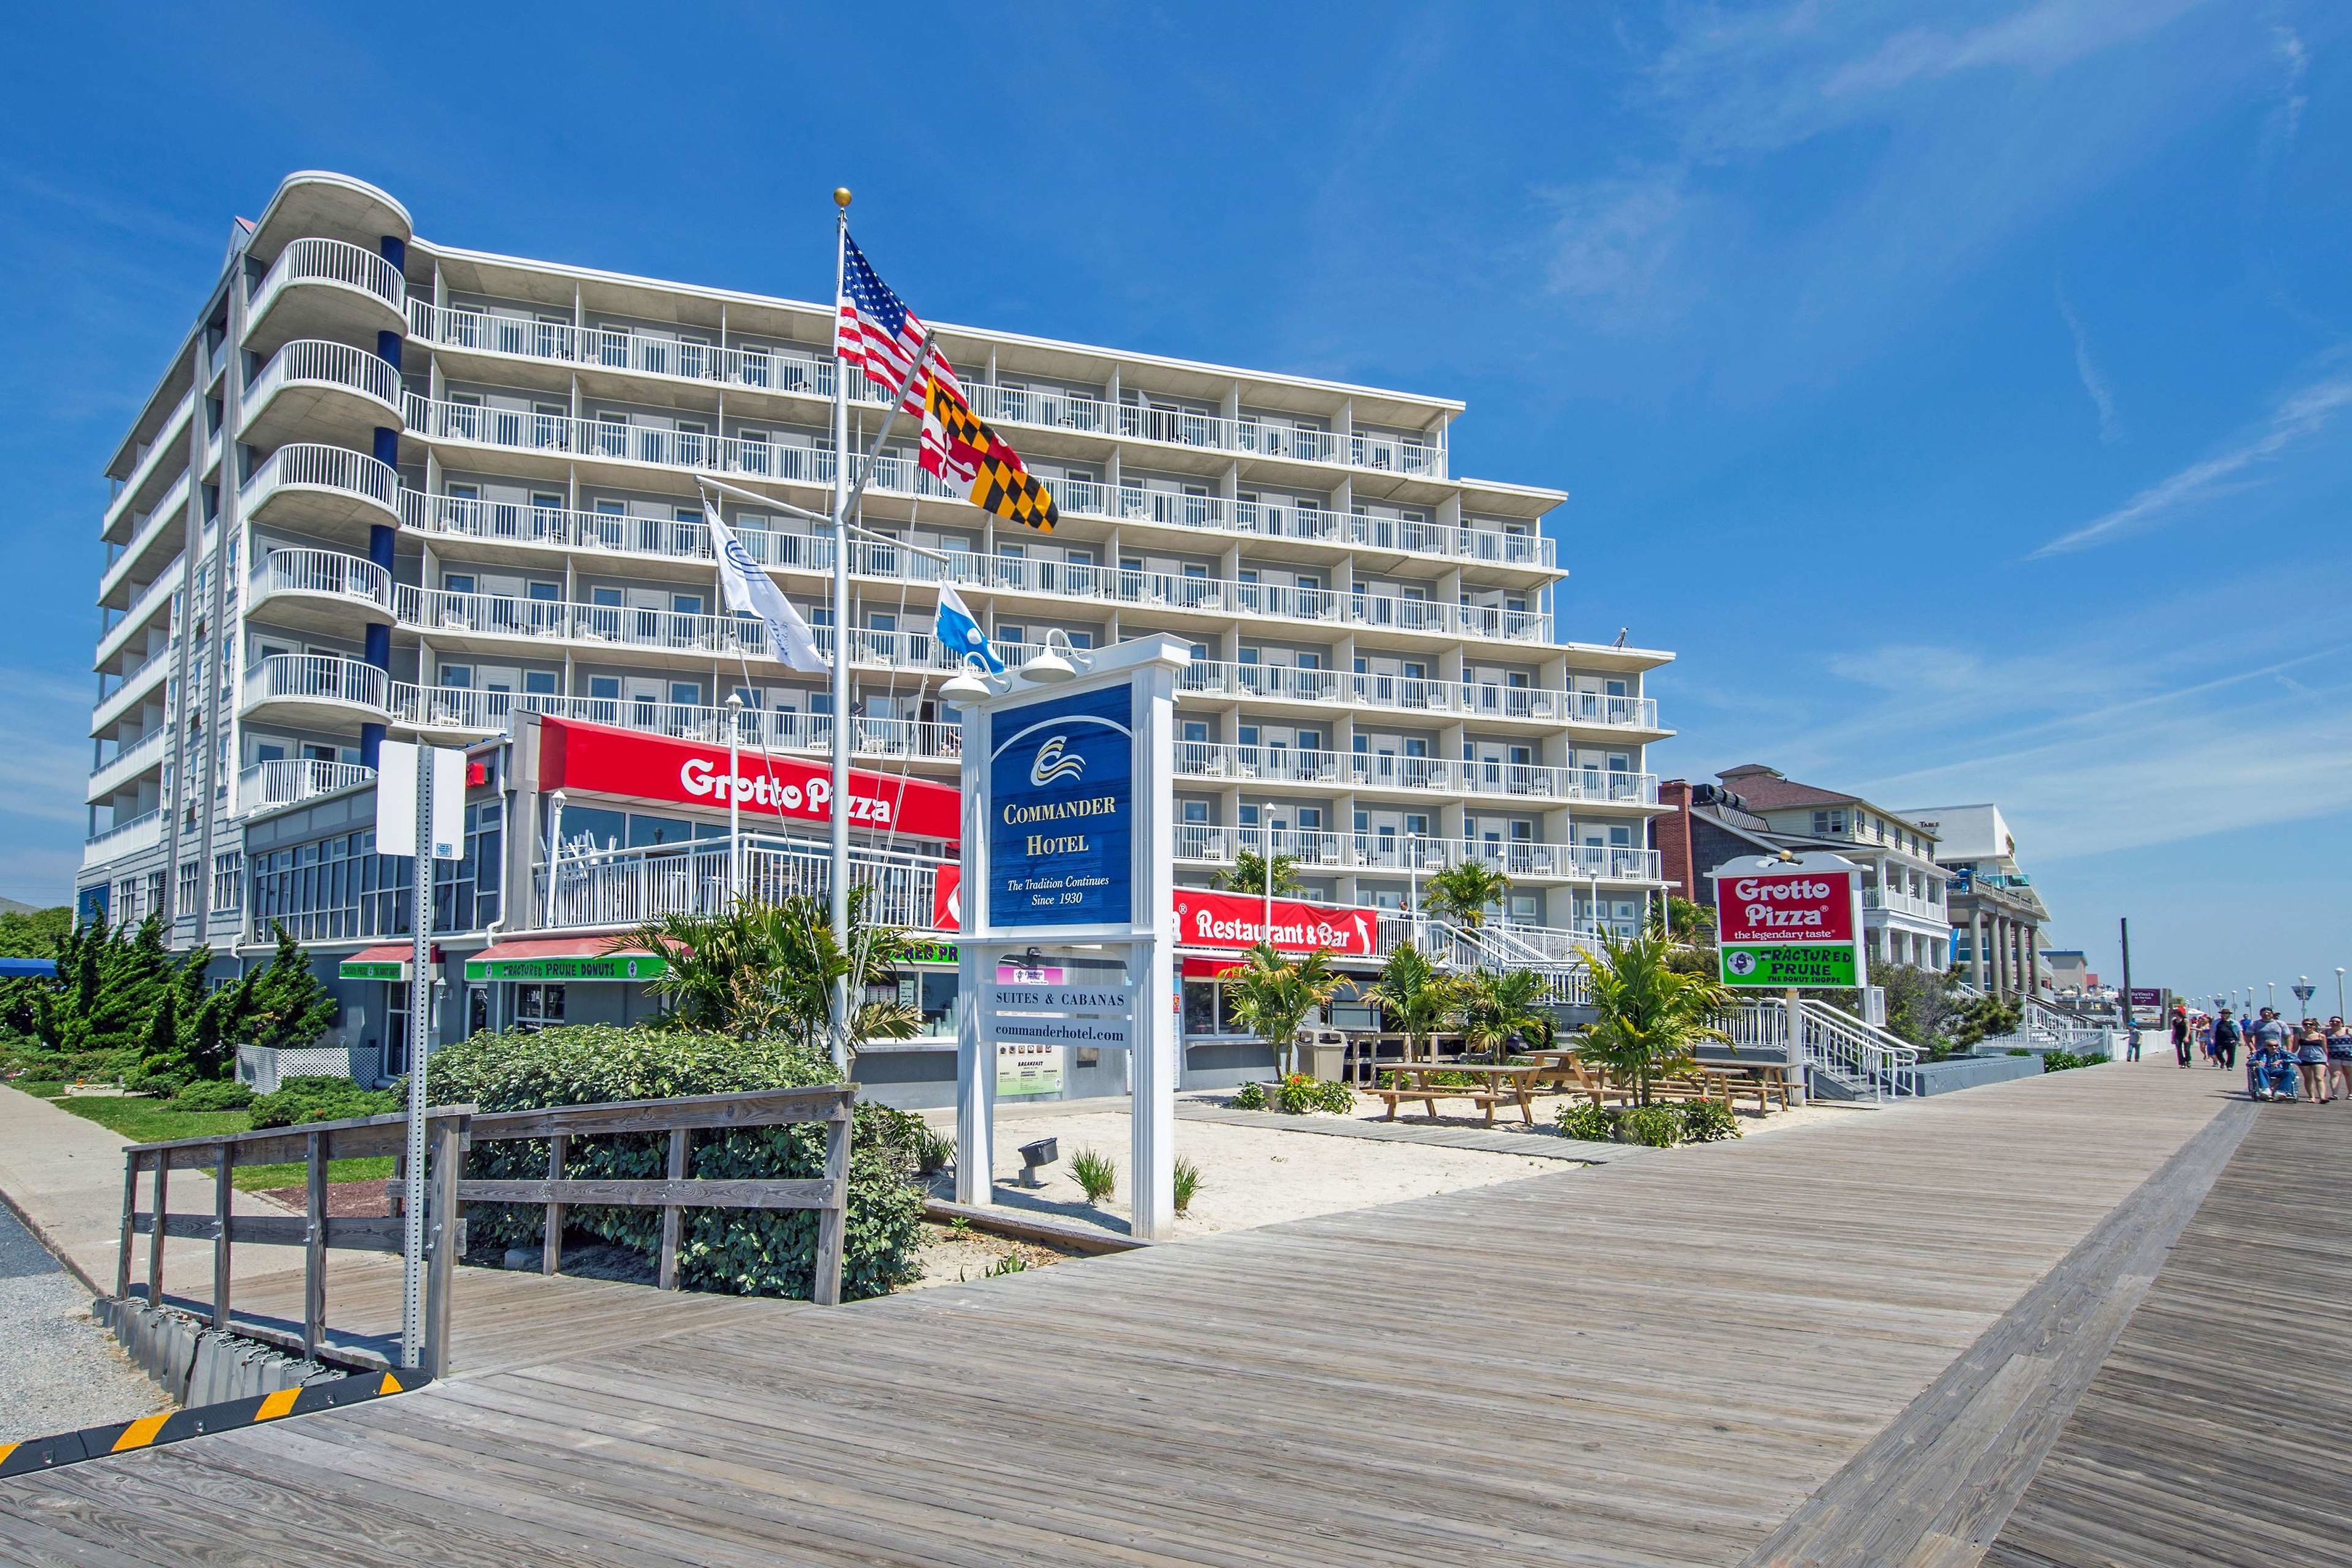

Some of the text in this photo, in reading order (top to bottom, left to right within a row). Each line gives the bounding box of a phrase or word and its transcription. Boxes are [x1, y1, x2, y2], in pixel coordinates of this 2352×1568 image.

[680, 758, 891, 823] Grotto Pzza
[1003, 796, 1116, 825] COMMANDER
[1026, 835, 1089, 857] HOTEL
[1008, 875, 1109, 891] The Tradition Continues
[1735, 878, 1830, 901] Grotto
[1032, 891, 1082, 906] Since 1930
[1196, 910, 1304, 944] Restaurant
[1306, 926, 1317, 944] &
[1316, 921, 1350, 948] Bar
[1734, 931, 1751, 939] the
[1752, 930, 1803, 940] legendary
[1760, 948, 1851, 963] FRACTURED
[503, 963, 615, 976] FRACTURED PRUNE DONUTS
[1771, 963, 1832, 976] PRUNE
[996, 992, 1124, 1007] SUITES & CABANAS
[995, 1024, 1124, 1042] commanderhotel.com
